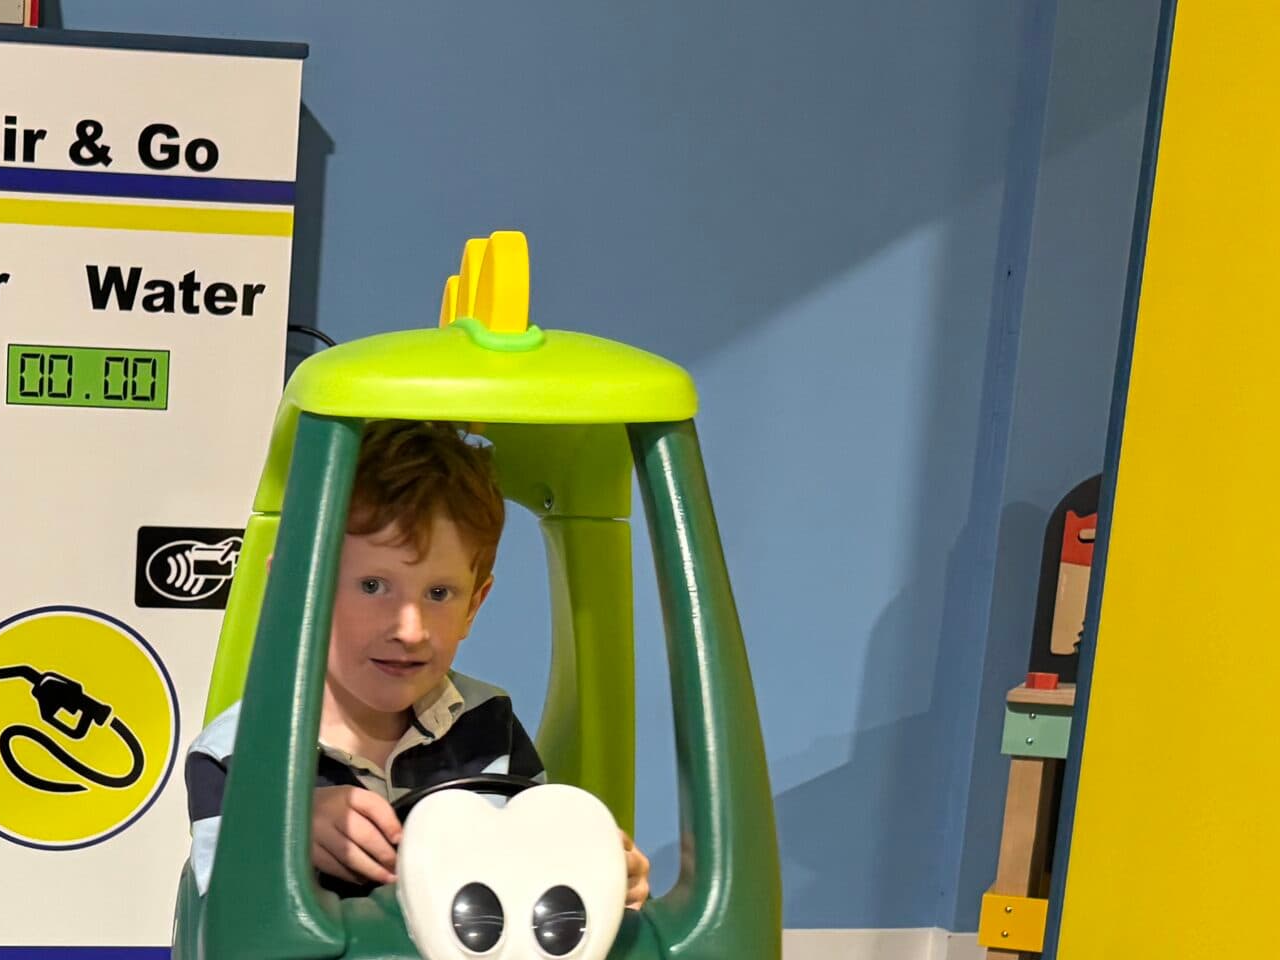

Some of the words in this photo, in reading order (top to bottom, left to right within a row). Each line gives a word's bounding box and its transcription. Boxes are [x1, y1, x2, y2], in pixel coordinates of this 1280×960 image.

[69, 119, 113, 167] &
[138, 123, 219, 172] Go
[86, 265, 265, 316] Water
[19, 353, 157, 402] 00.00
